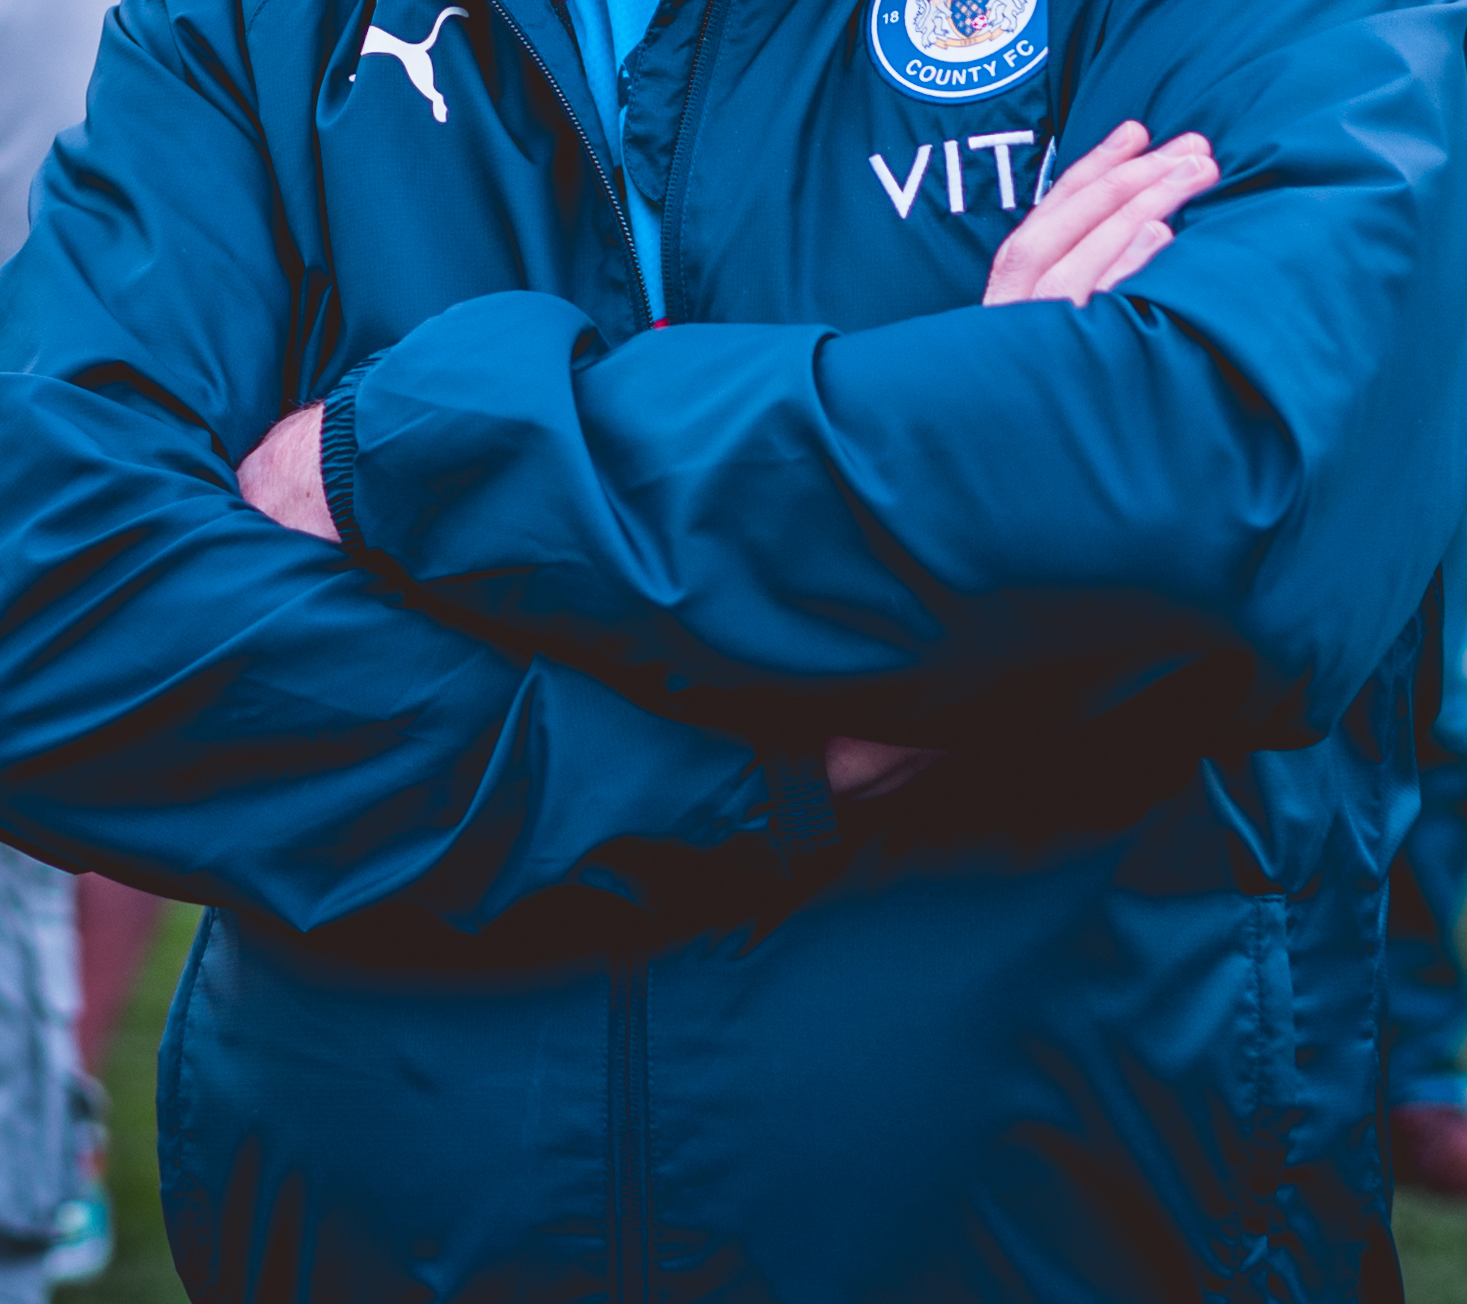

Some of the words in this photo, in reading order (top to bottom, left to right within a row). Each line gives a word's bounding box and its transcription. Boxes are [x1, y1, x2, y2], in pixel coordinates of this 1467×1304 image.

[882, 10, 900, 25] 18
[905, 59, 997, 86] COUNTY
[1003, 39, 1034, 68] FC
